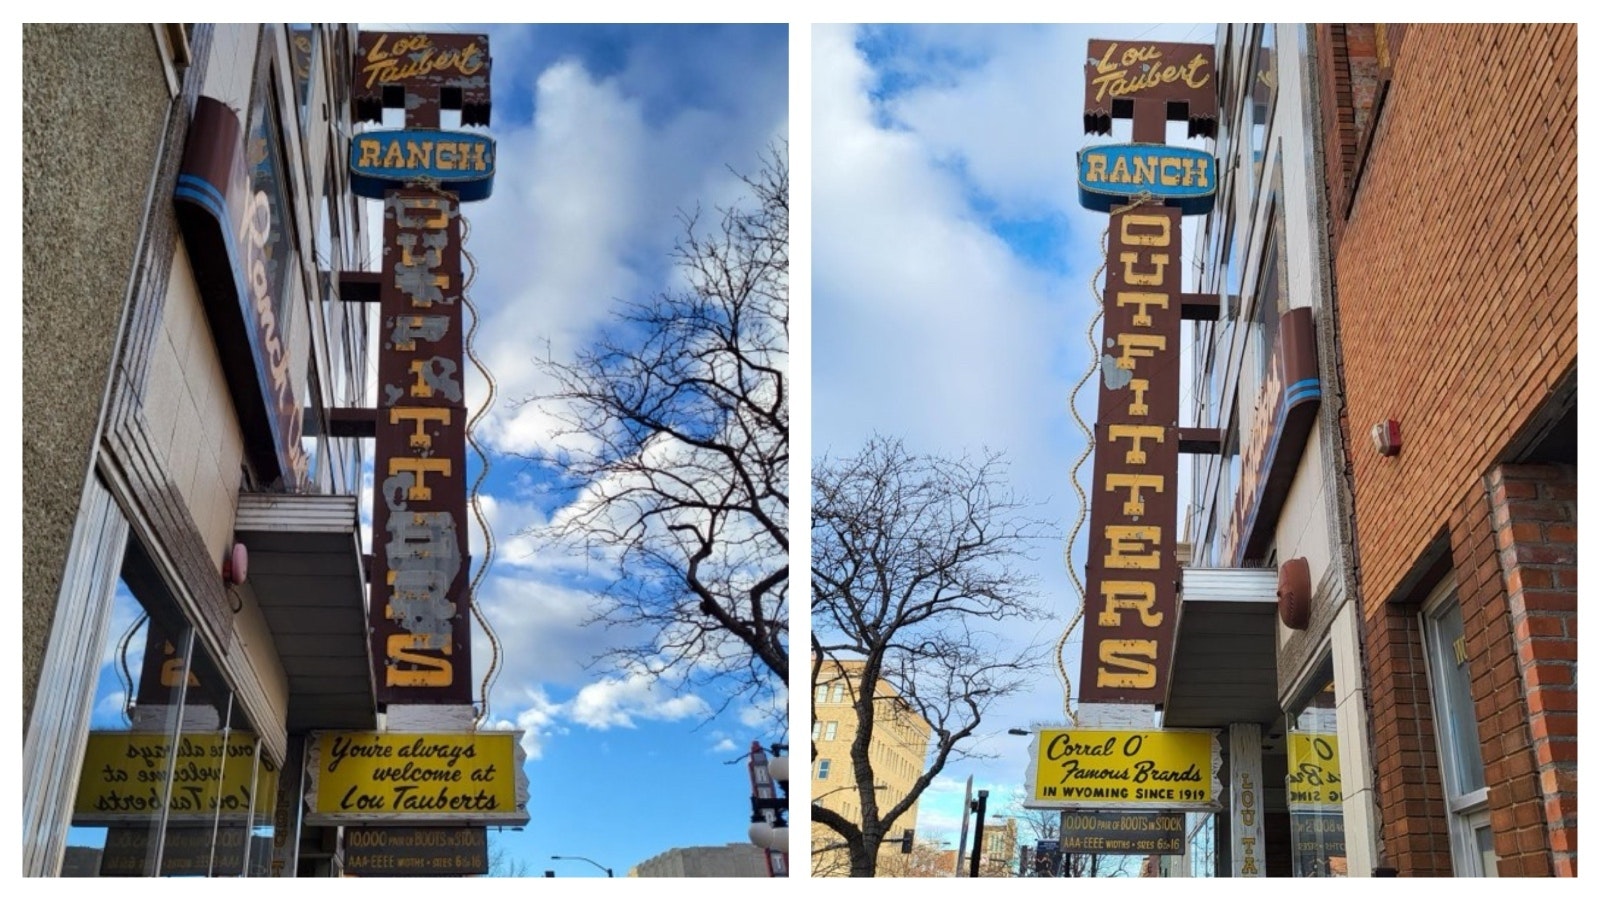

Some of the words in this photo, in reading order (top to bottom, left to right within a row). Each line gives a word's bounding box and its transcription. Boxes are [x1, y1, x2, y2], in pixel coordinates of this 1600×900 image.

[366, 34, 429, 63] Lou
[1096, 43, 1162, 74] Lou
[362, 43, 483, 89] Taubert
[1092, 54, 1210, 102] Taubert
[358, 140, 487, 171] RANCH
[1086, 154, 1208, 187] RANCH
[1097, 214, 1171, 688] OUTFITTERS
[397, 738, 476, 767] always
[1047, 733, 1117, 761] Corral
[373, 761, 462, 782] welcome
[471, 764, 496, 782] at
[1060, 759, 1130, 784] Famous
[1133, 760, 1202, 783] Brands
[340, 785, 385, 810] Lou
[392, 786, 500, 810] Tauberts
[1043, 786, 1057, 797] IN
[1063, 787, 1128, 799] WYOMING
[1136, 788, 1174, 799] SINCE
[1179, 789, 1205, 800] 1919
[1241, 773, 1255, 826] LOU
[1064, 815, 1097, 831] 10,000
[1120, 816, 1148, 831] BOOTS
[1155, 816, 1182, 831] STOCK
[349, 831, 388, 847] 10,000
[415, 831, 447, 846] BOOTS
[1063, 836, 1104, 849] AAA-EEEE
[1106, 839, 1131, 849] WIDTHS
[1241, 837, 1258, 877] TA
